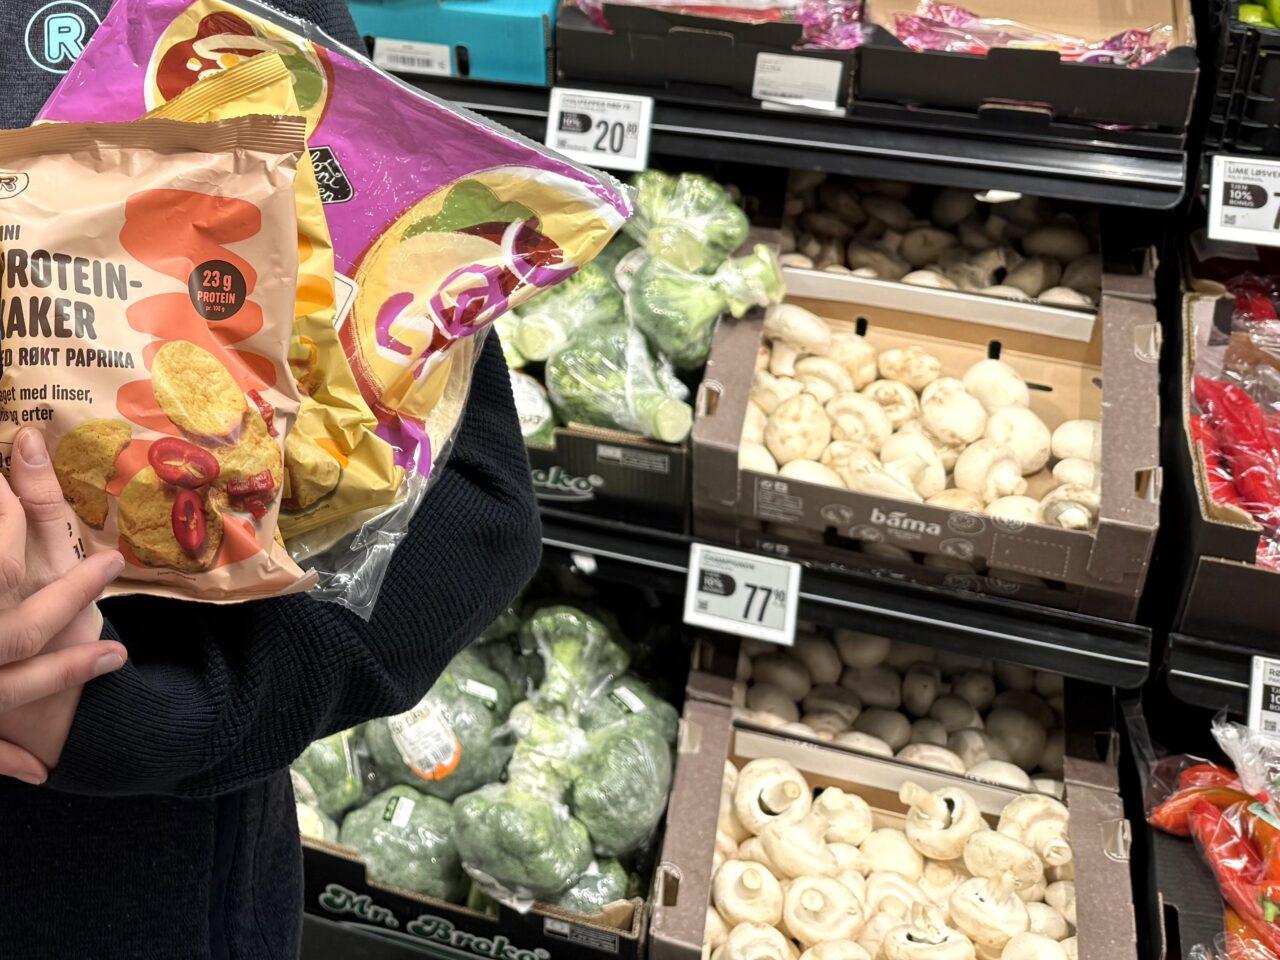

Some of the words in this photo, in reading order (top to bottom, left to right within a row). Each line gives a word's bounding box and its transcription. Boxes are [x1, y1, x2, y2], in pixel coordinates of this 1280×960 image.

[44, 13, 86, 63] R
[593, 120, 625, 154] 20
[1228, 166, 1250, 176] LIME
[1229, 189, 1253, 201] 10%
[203, 270, 221, 288] 23
[223, 274, 232, 292] g
[197, 290, 236, 305] PROTEIN
[18, 347, 60, 367] RØKT
[65, 347, 135, 369] PAPRIKA
[20, 384, 48, 401] med
[52, 384, 93, 404] linser,
[21, 406, 54, 422] erter
[744, 583, 773, 623] 77
[319, 883, 400, 928] Mr.
[407, 914, 538, 960] Broko
